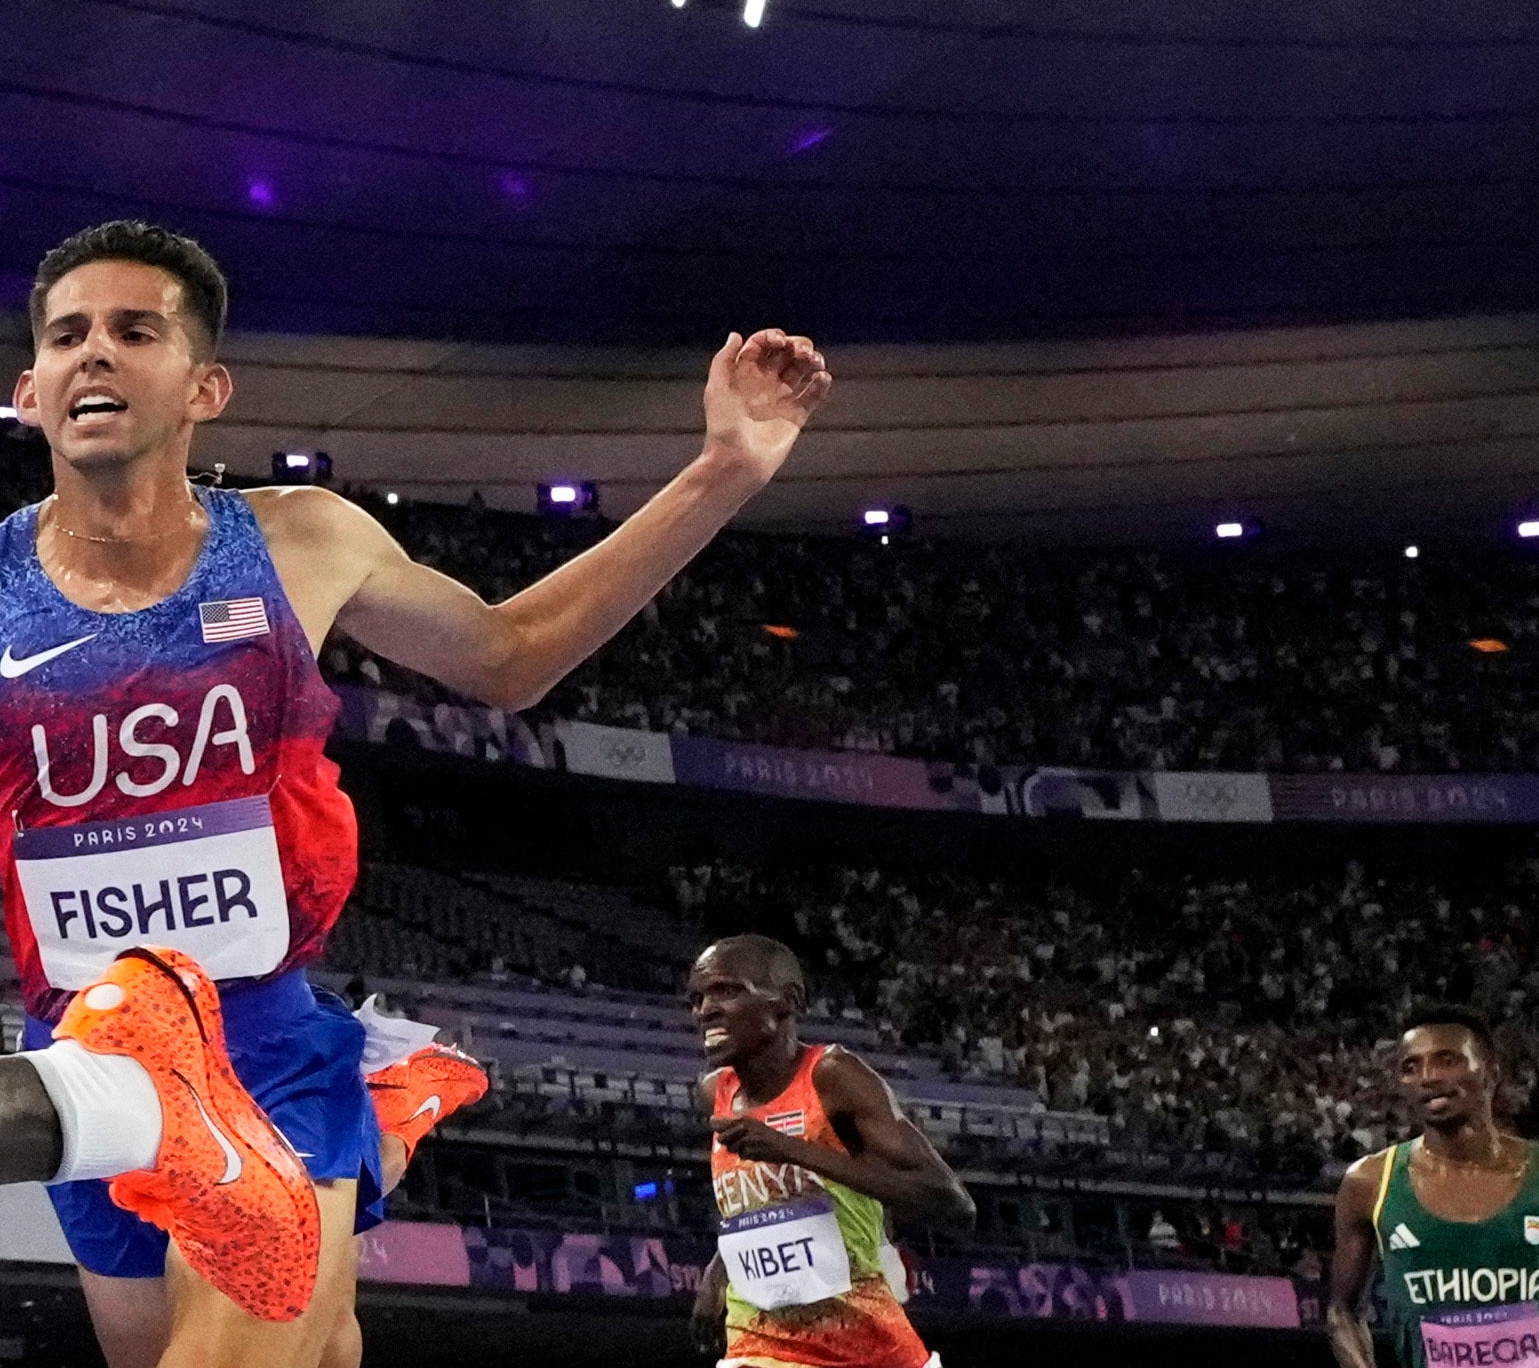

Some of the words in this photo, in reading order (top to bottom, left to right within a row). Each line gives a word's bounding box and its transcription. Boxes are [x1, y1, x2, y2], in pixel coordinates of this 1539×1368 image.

[31, 683, 256, 808] USA
[73, 825, 137, 847] PARIS
[144, 817, 204, 839] 2024
[49, 867, 259, 940] FISHER
[738, 1237, 815, 1281] KIBET
